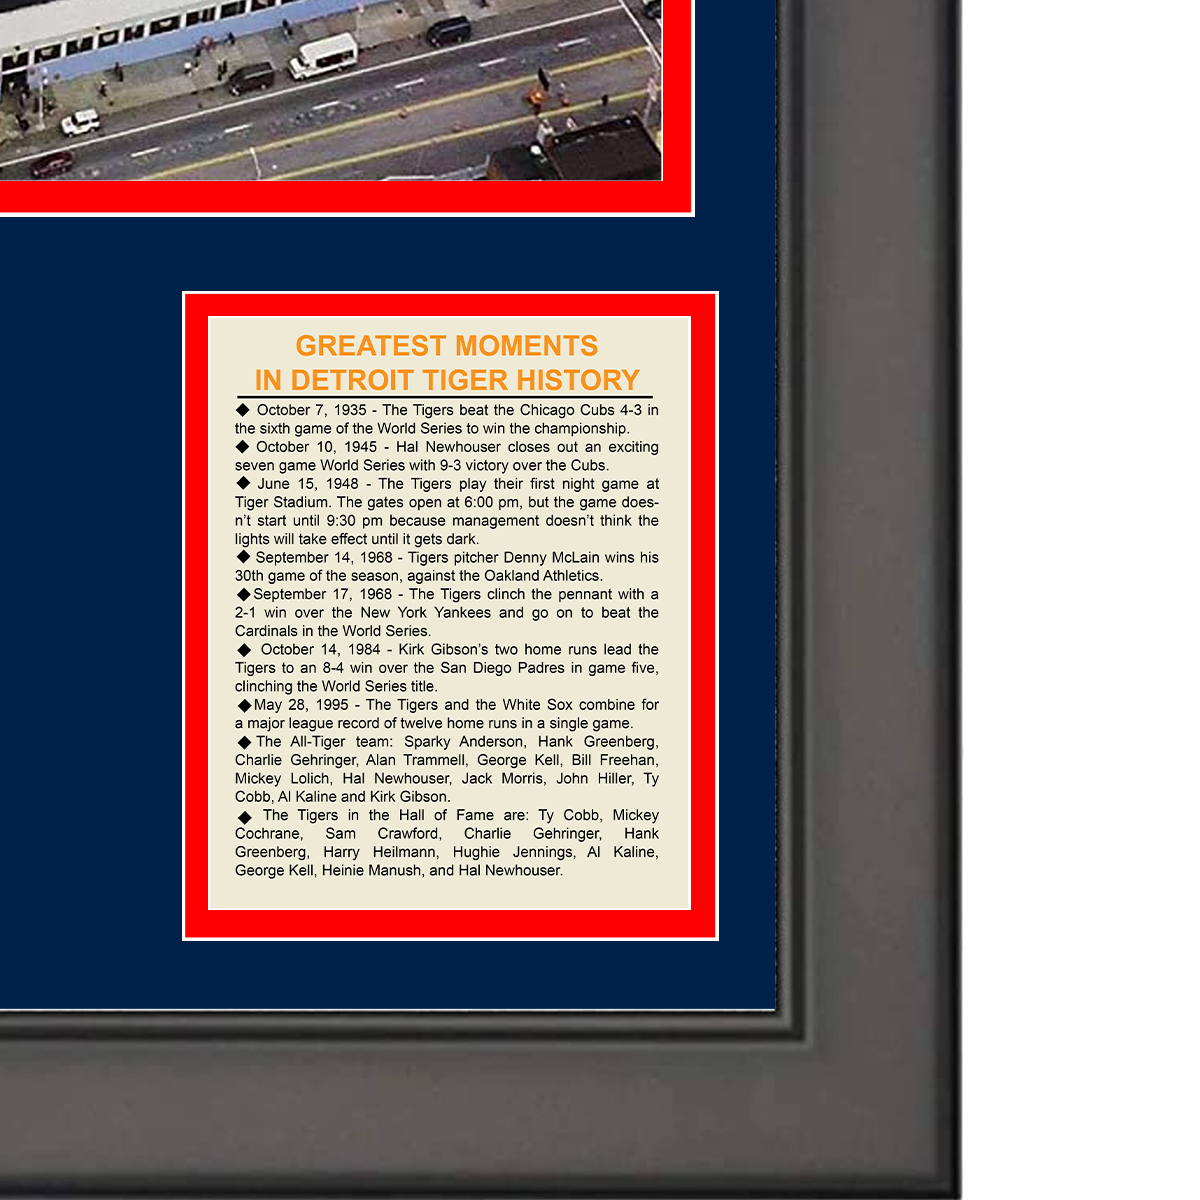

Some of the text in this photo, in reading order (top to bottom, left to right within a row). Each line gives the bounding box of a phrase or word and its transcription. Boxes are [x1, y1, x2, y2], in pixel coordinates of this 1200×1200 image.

[295, 334, 598, 357] GREATEST MOMENTS
[255, 368, 641, 391] IN DETROIT TIGER HISTORY
[256, 403, 311, 416] October
[315, 403, 328, 418] 7,
[334, 403, 367, 416] 1935
[381, 403, 408, 416] The
[412, 403, 454, 420] Tigers
[459, 403, 489, 416] beat
[493, 403, 515, 416] the
[519, 403, 575, 419] Chicago
[580, 403, 615, 416] Cubs
[619, 403, 643, 416] 4-3
[647, 403, 659, 416] in
[234, 421, 630, 438] the sixth game of the World Series to win the championship.
[234, 458, 610, 475] seven game World Series with 9-3 victory over the Cubs.
[234, 495, 660, 512] Tiger Stadium. The gates open at 6:00 pm, but the game does-
[235, 513, 659, 530] n’t start until 9:30 pm because management doesn’t think the
[255, 550, 330, 567] September
[334, 551, 354, 566] 14,
[360, 550, 393, 564] 1968
[407, 550, 449, 567] Tigers
[454, 550, 499, 567] pitcher
[503, 550, 547, 567] Denny
[552, 551, 600, 564] McLain
[604, 550, 635, 564] wins
[640, 550, 660, 564] his
[234, 568, 603, 585] 30th game of the season, against the Oakland Athletics.
[234, 679, 438, 696] clinching the World Series title.
[255, 734, 659, 751] The All-Tiger team: Sparky Anderson, Hank Greenberg,
[235, 753, 659, 769] Charlie Gehringer, Alan Trammell, George Kell, Bill Freehan,
[235, 771, 660, 788] Mickey Lolich, Hal Newhouser, Jack Morris, John Hiller, Ty
[235, 789, 451, 805] Cobb, Al Kaline and Kirk Gibson.
[262, 808, 660, 825] The Tigers in the Hall of Fame are: Ty Cobb, Mickey
[235, 826, 660, 843] Cochrane, Sam Crawford, Charlie Gehringer, Hank
[235, 845, 659, 861] Greenberg, Harry Heilmann, Hughie Jennings, Al Kaline,
[235, 863, 563, 880] George Kell, Heinie Manush, and Hal Newhouser.
